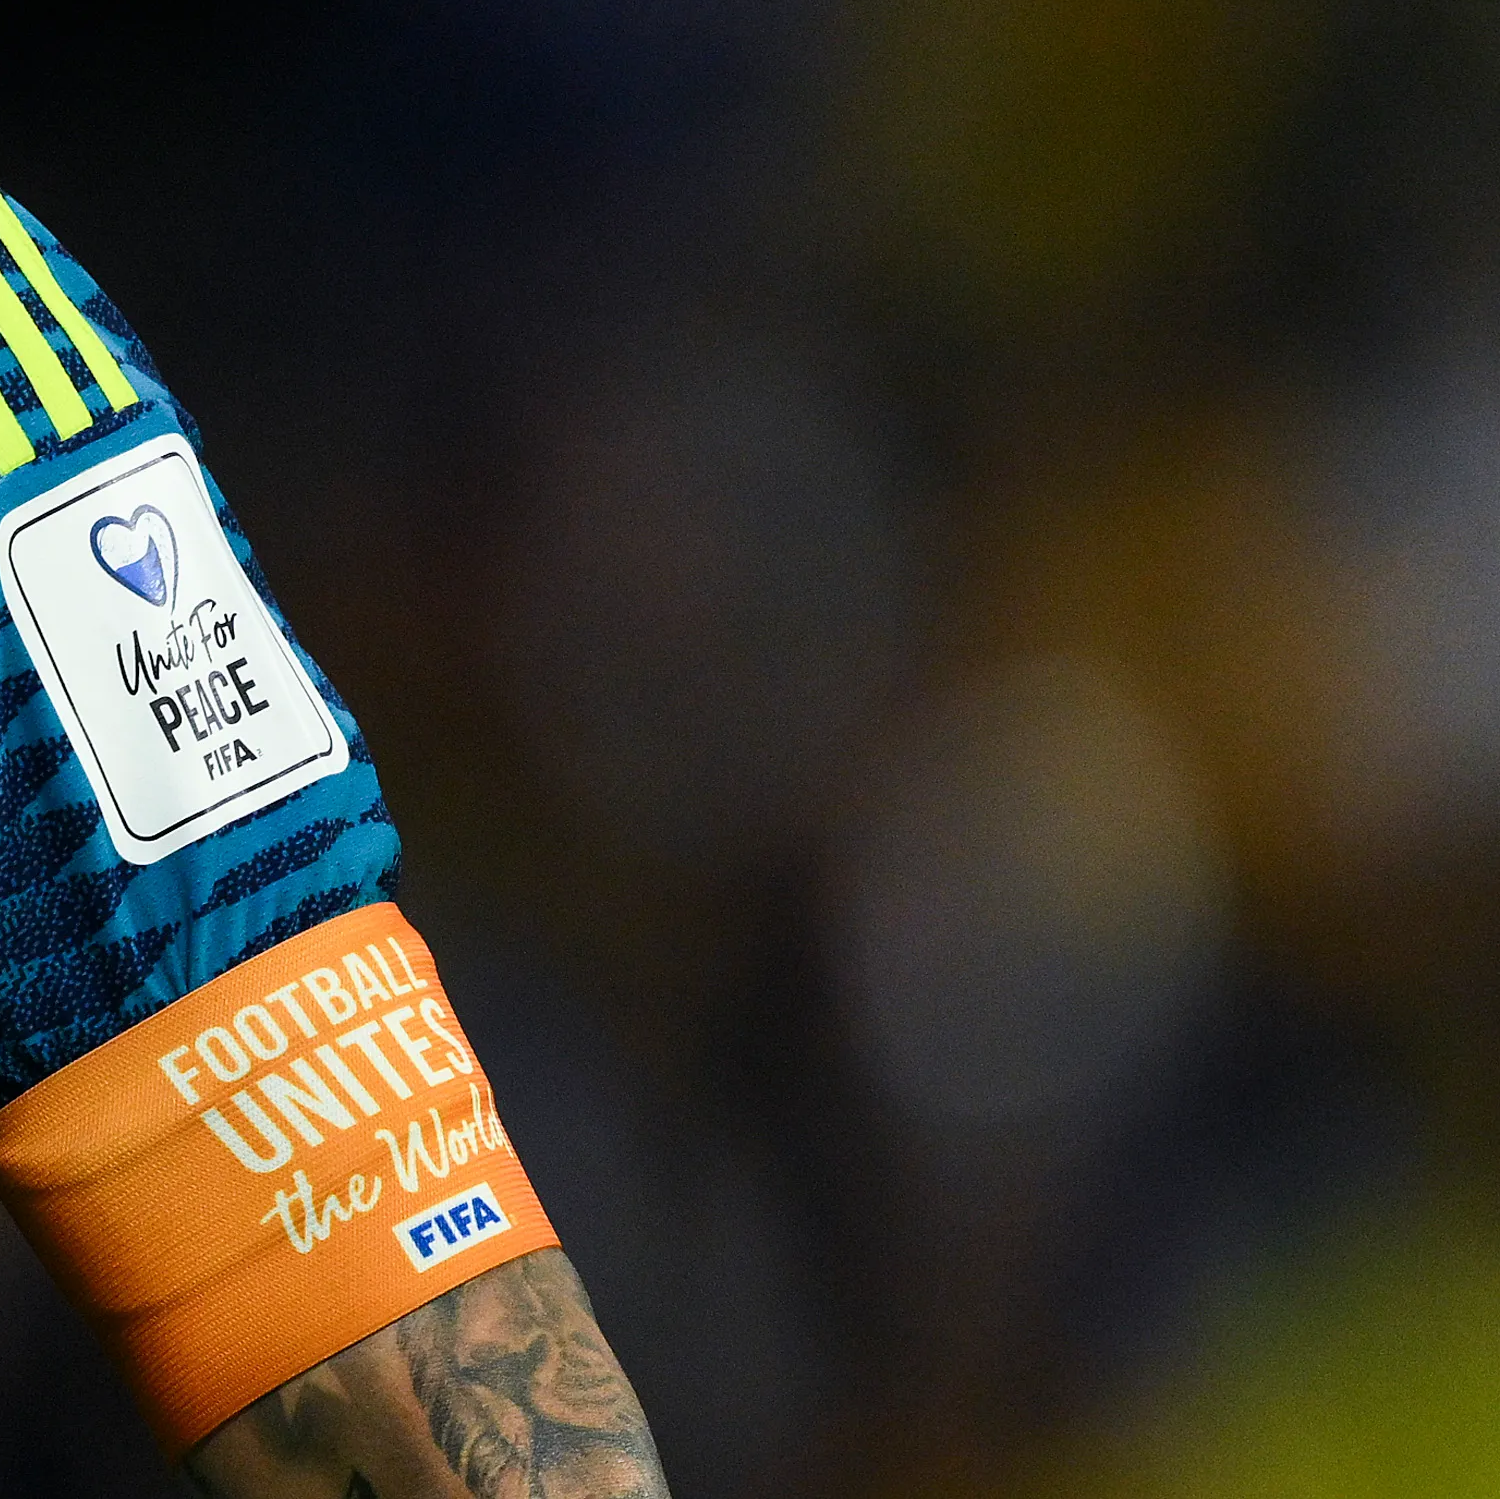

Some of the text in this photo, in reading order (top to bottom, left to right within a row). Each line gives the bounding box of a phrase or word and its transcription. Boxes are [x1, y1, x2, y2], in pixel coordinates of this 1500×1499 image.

[116, 598, 238, 696] Unite For
[149, 656, 271, 754] PEACE
[203, 738, 258, 782] FIFA
[157, 936, 429, 1106] FOOTBALL
[199, 997, 474, 1174] UNITES
[259, 1082, 515, 1255] the World
[408, 1195, 502, 1259] FIFA
